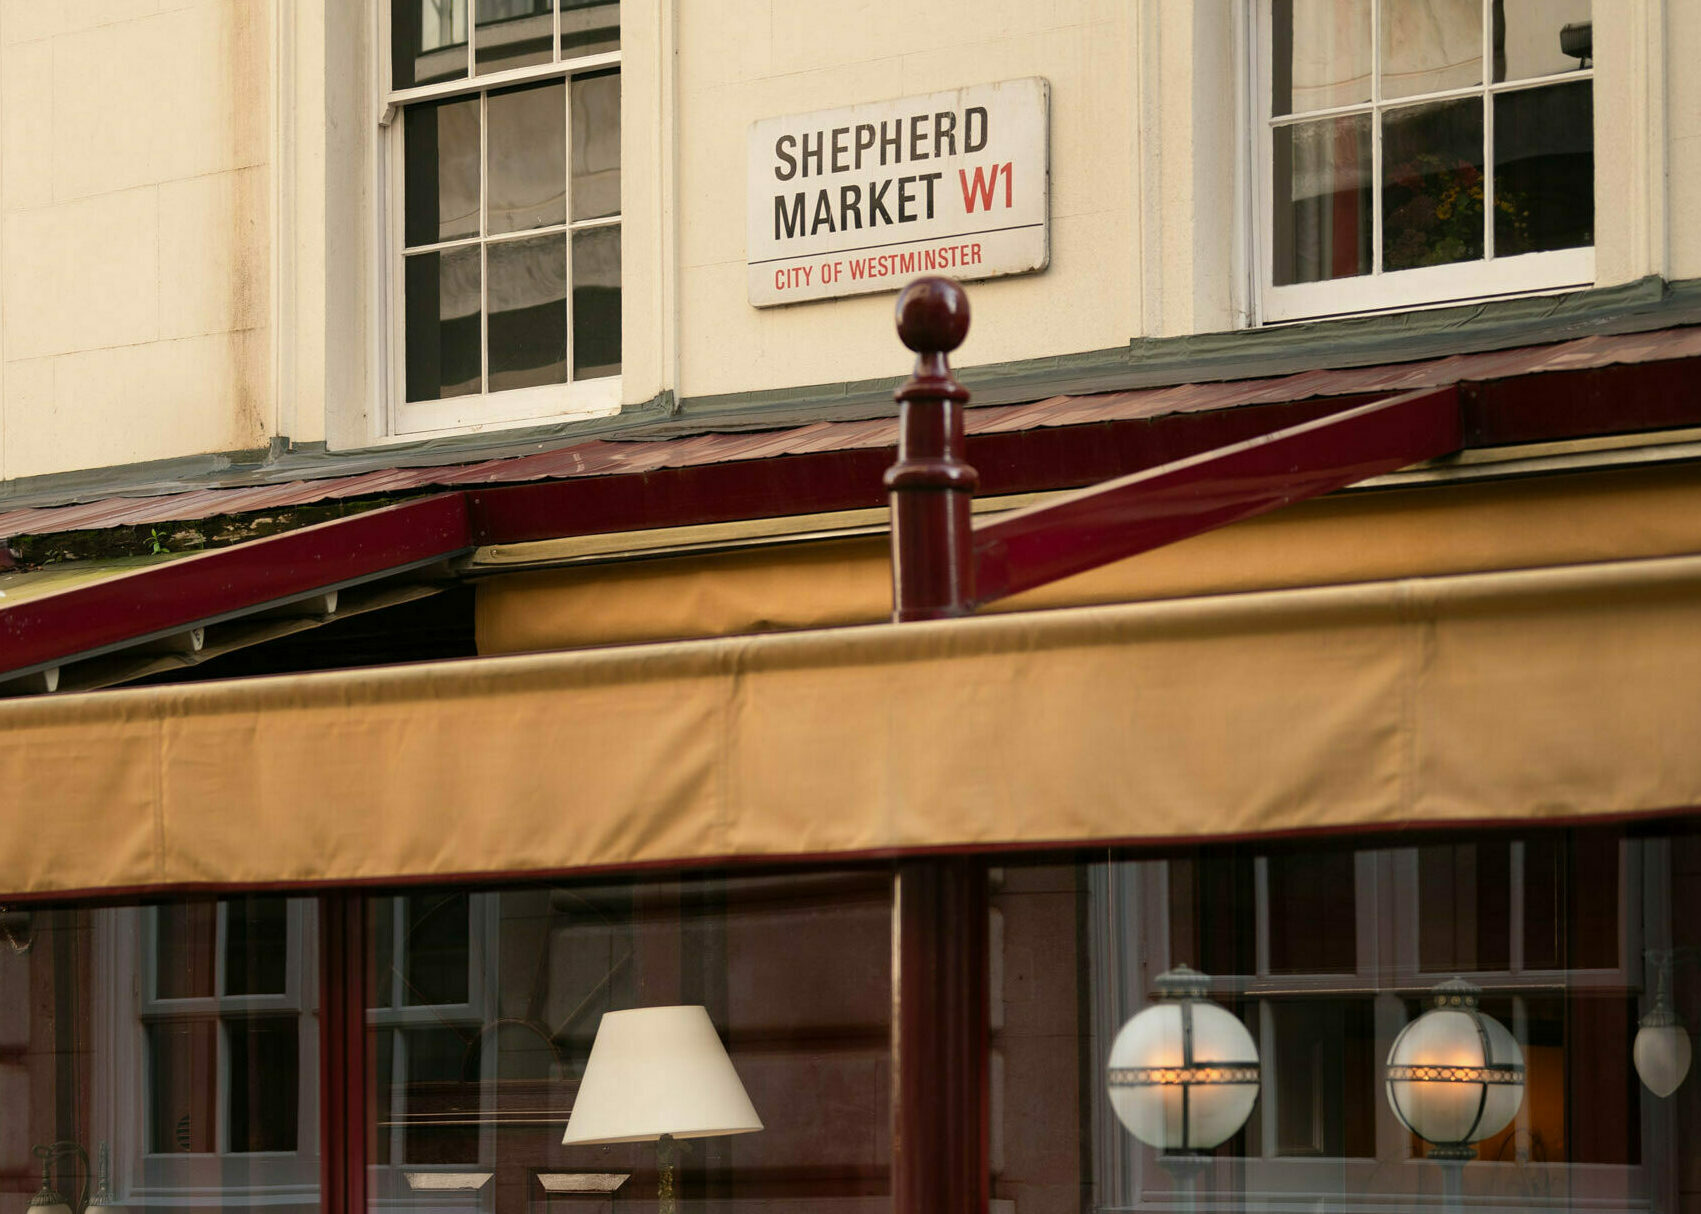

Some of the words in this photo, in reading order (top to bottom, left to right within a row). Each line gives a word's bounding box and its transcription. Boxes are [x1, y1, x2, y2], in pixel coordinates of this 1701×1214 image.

[774, 106, 988, 181] SHEPHERD
[774, 172, 942, 240] MARKET
[959, 162, 1013, 214] W1
[775, 265, 813, 290] CITY
[821, 262, 843, 284] OF
[849, 243, 982, 280] WESTMINSTER
